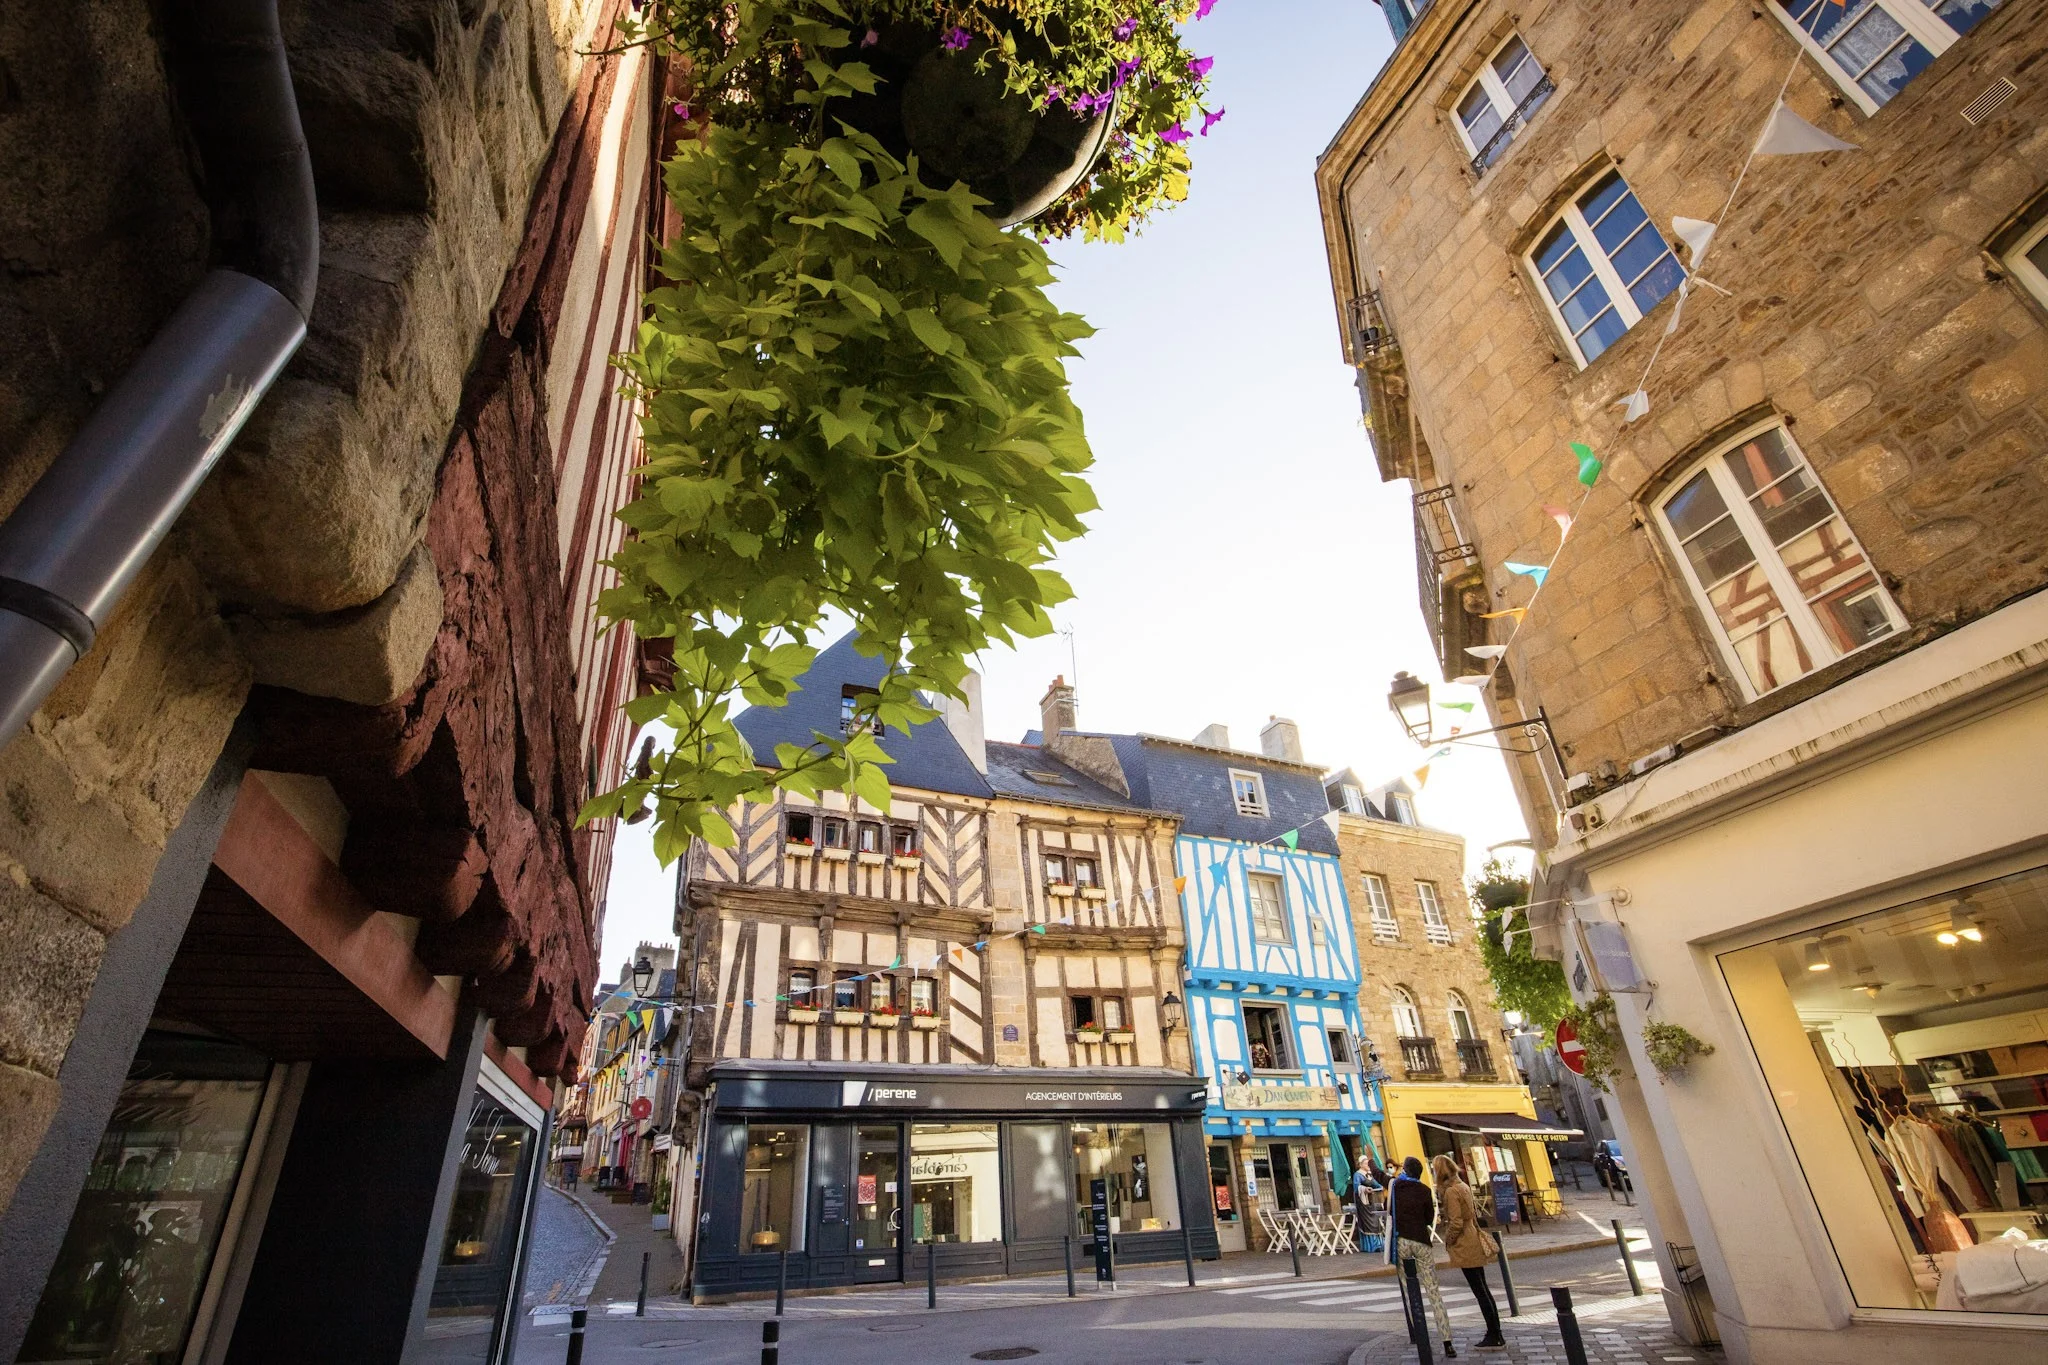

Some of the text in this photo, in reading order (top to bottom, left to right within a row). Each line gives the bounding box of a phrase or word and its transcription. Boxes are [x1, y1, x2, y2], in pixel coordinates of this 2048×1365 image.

[1025, 1090, 1123, 1101] AGENCEMENT D'INTÉRIEURS
[1502, 1133, 1512, 1141] LES
[1550, 1134, 1569, 1142] PATERN
